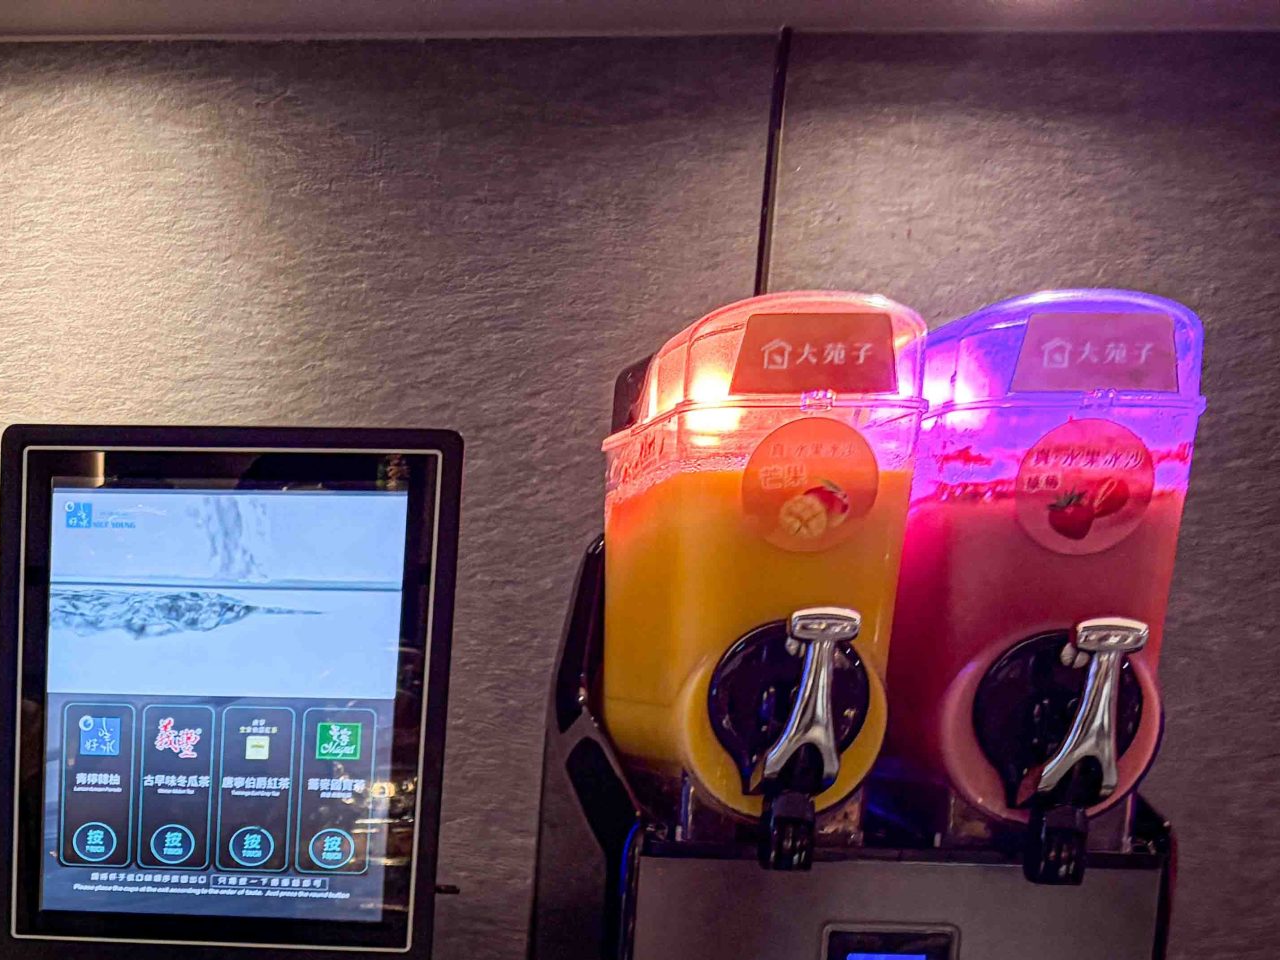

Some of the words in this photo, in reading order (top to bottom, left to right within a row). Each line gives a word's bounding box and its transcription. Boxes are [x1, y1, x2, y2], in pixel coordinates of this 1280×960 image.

[796, 341, 872, 365] 大苑子
[1078, 340, 1153, 365] 大苑子
[759, 464, 808, 490] 芒果
[144, 774, 210, 787] 古早味冬瓜茶
[87, 830, 104, 844] 按
[165, 832, 182, 847] 按
[243, 833, 261, 849] 按
[323, 836, 342, 851] 按
